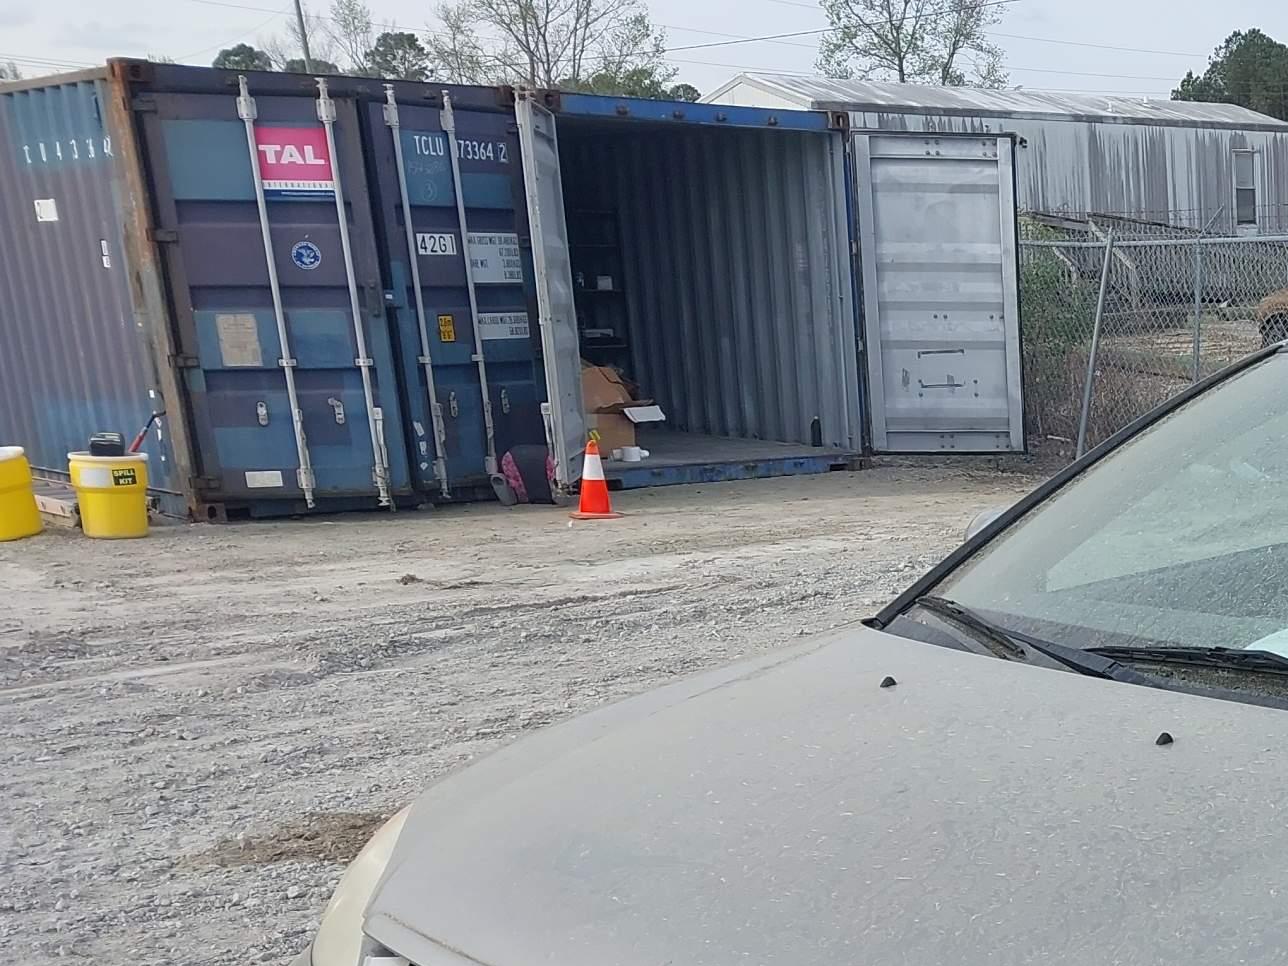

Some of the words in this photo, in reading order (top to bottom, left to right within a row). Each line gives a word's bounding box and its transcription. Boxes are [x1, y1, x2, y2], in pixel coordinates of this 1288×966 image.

[258, 144, 326, 165] TAL
[413, 135, 445, 156] TCLU
[420, 235, 455, 254] 42G1
[114, 469, 134, 477] SPILL
